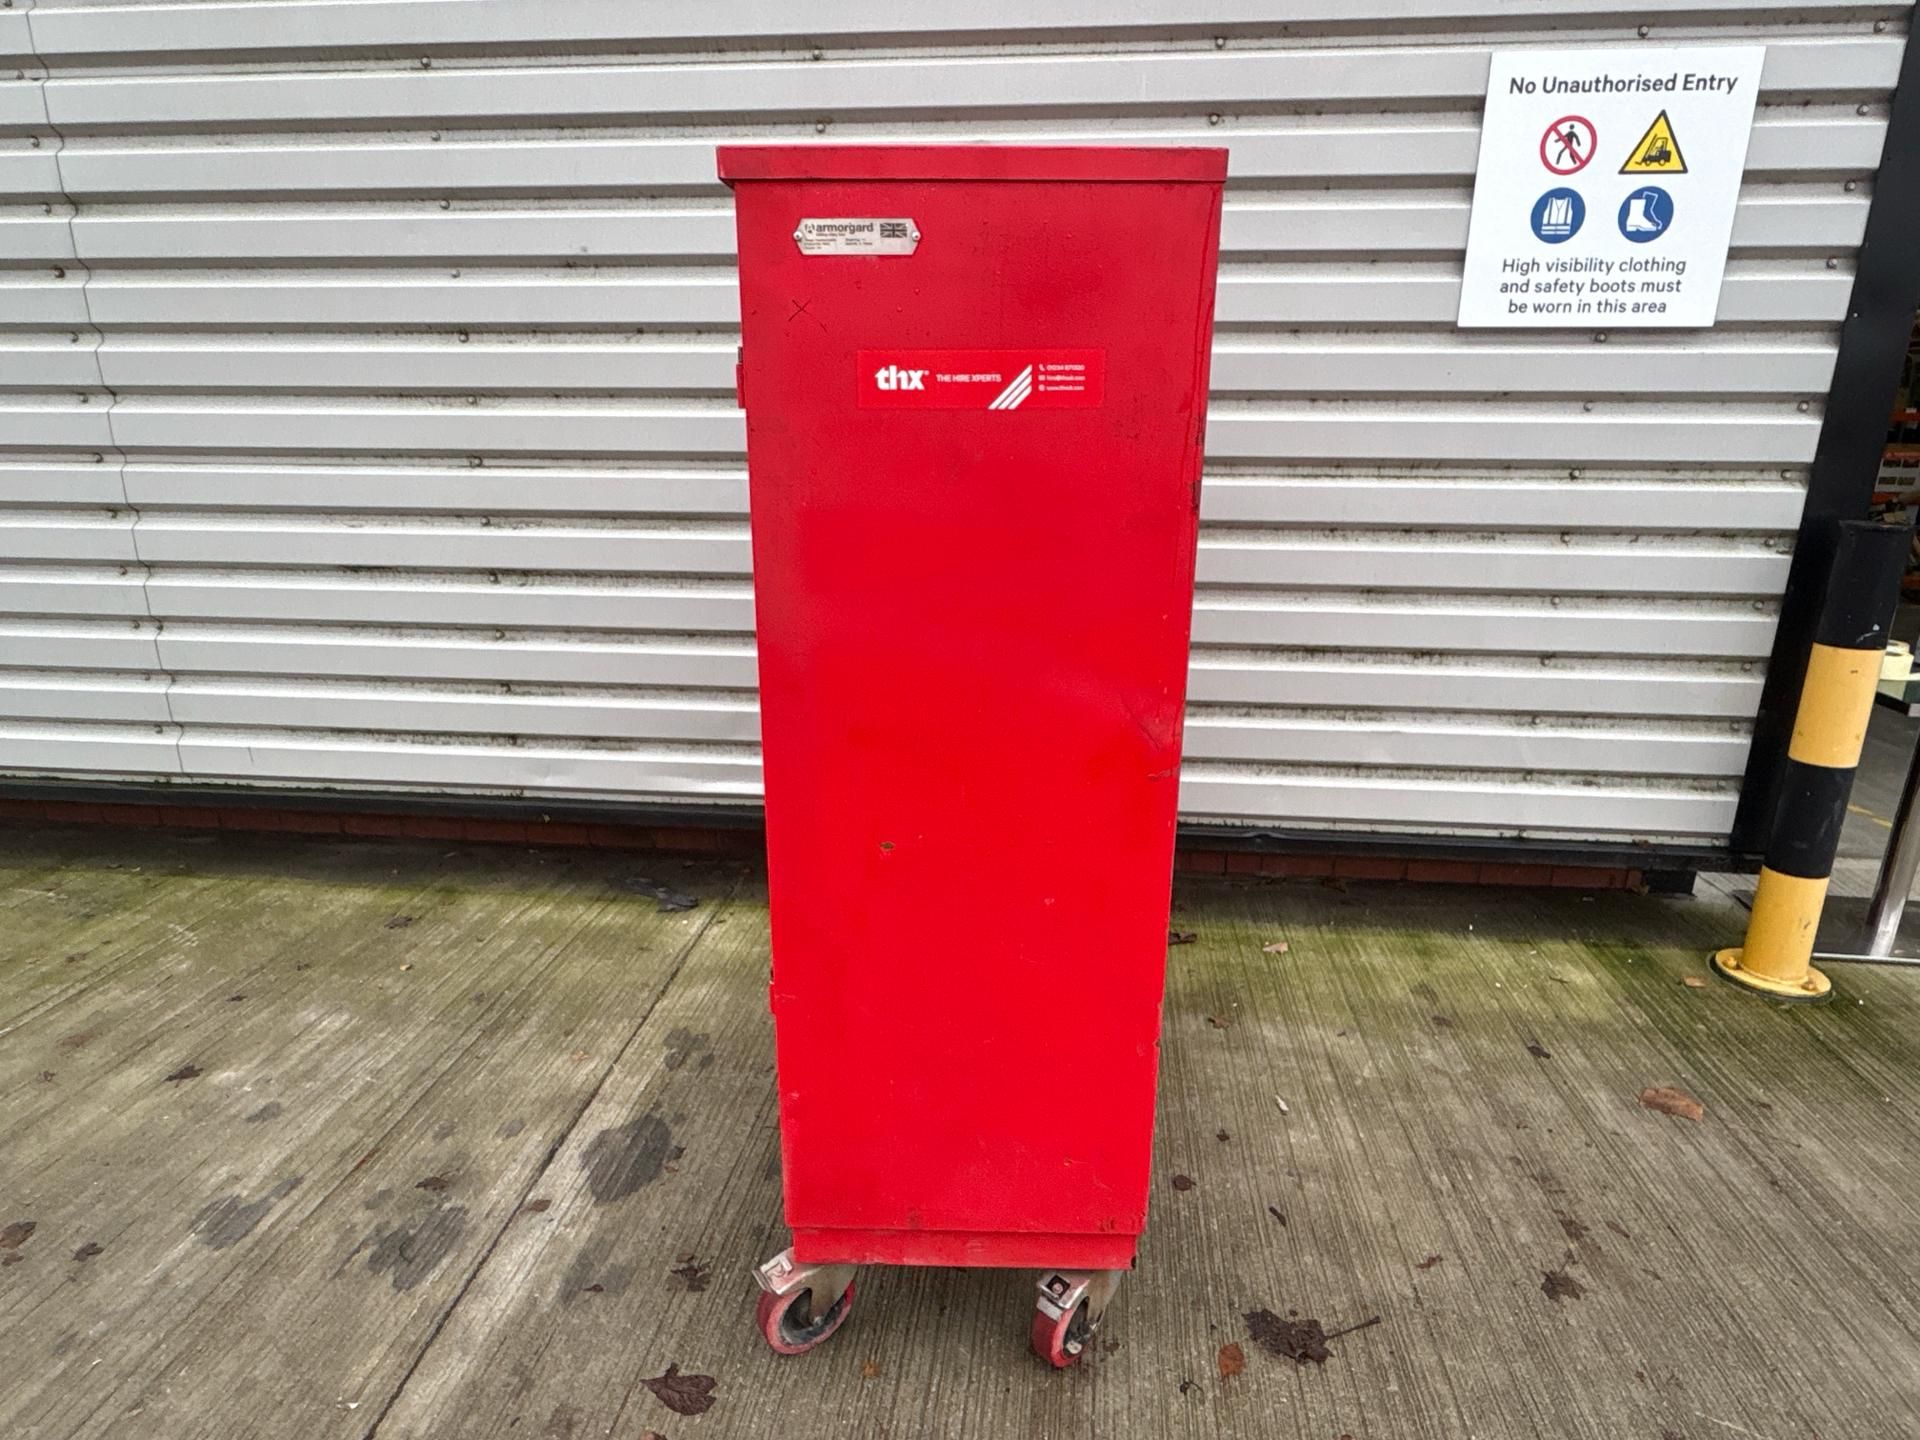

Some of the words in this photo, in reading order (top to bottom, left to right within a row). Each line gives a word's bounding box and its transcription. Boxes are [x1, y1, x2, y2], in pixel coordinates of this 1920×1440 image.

[1510, 78, 1536, 94] No
[1543, 73, 1677, 93] Unauthorised
[1683, 74, 1738, 94] Entry
[816, 223, 874, 234] armorgard
[1503, 258, 1539, 276] High
[1547, 258, 1614, 275] visibility
[1619, 258, 1686, 275] clothing
[1500, 279, 1529, 293] and
[1535, 279, 1584, 295] safety
[1590, 279, 1635, 292] boots
[1641, 280, 1681, 292] must
[1509, 300, 1527, 313] be
[1533, 302, 1571, 313] worn
[1578, 300, 1591, 312] in
[1598, 299, 1626, 312] this
[1632, 302, 1666, 312] area
[875, 365, 924, 390] thx
[936, 374, 951, 382] THE
[952, 374, 969, 382] HIRE
[970, 374, 1002, 382] XPERTS
